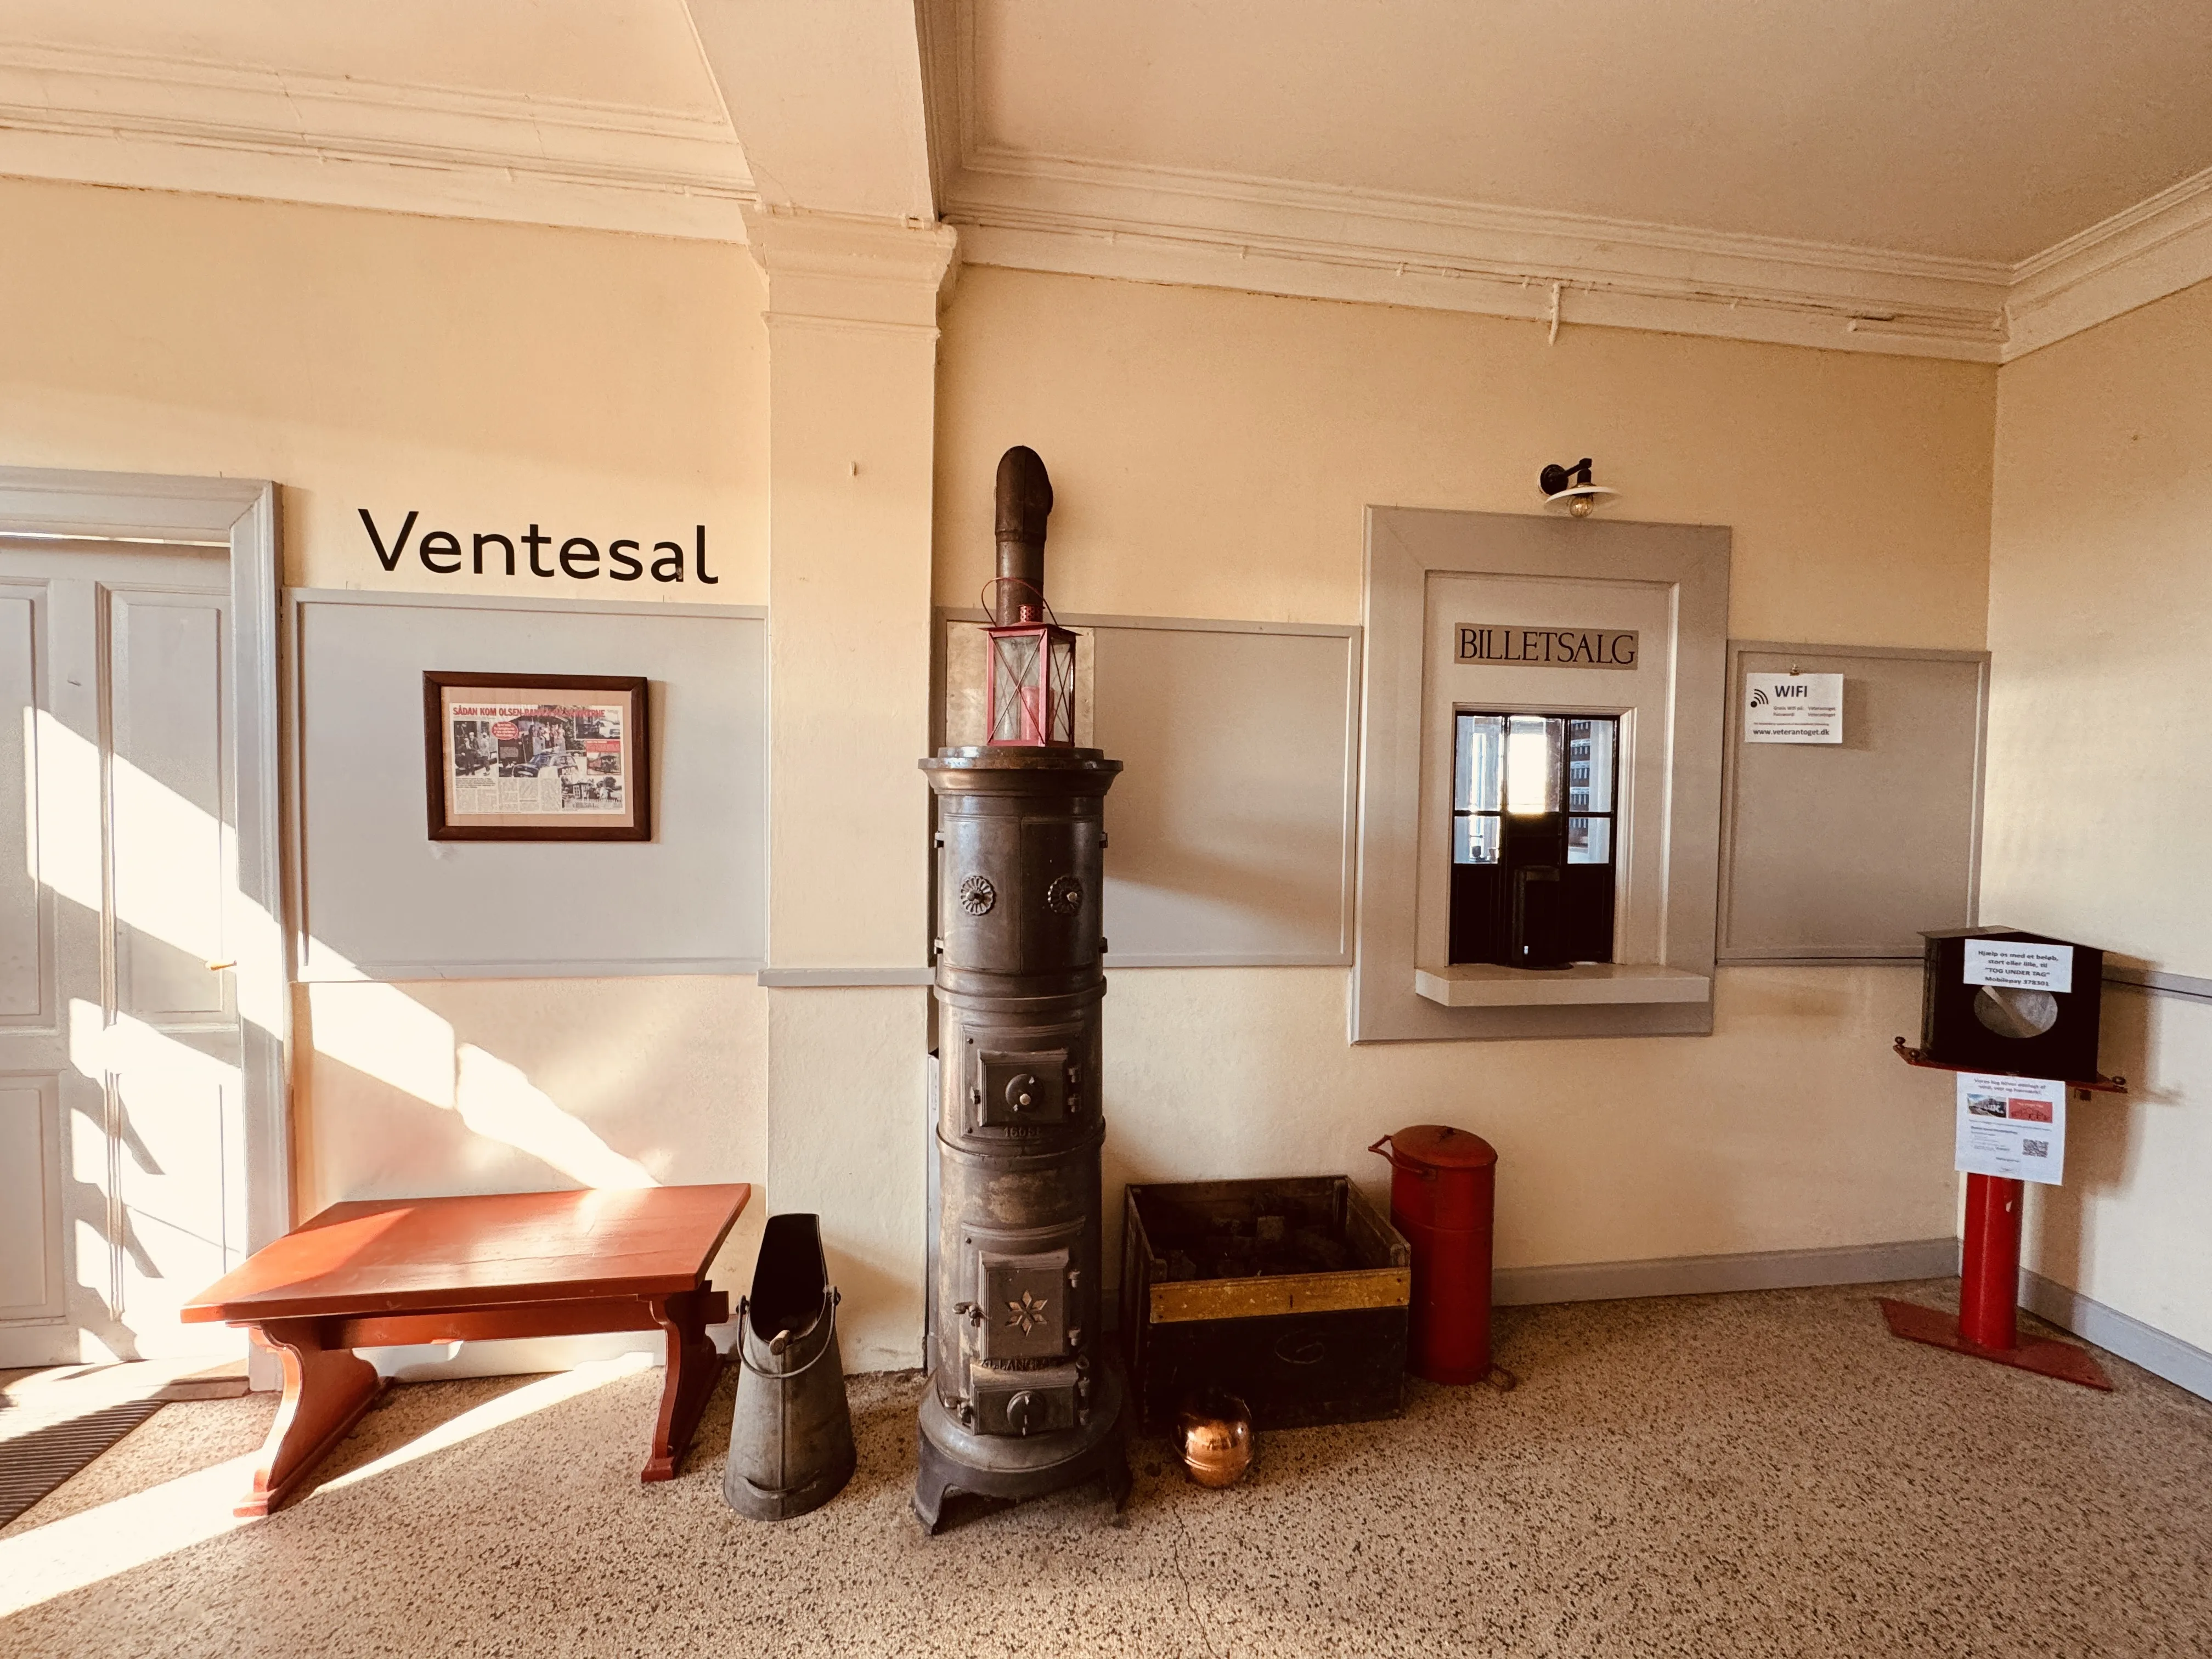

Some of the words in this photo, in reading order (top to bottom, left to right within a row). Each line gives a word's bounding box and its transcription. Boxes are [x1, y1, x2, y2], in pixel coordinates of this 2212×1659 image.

[357, 508, 719, 584] Ventesal
[1460, 628, 1635, 665] BILLETSALG
[1775, 685, 1808, 697] WIFI
[453, 704, 478, 716] SÅDAN
[480, 707, 497, 716] KOM
